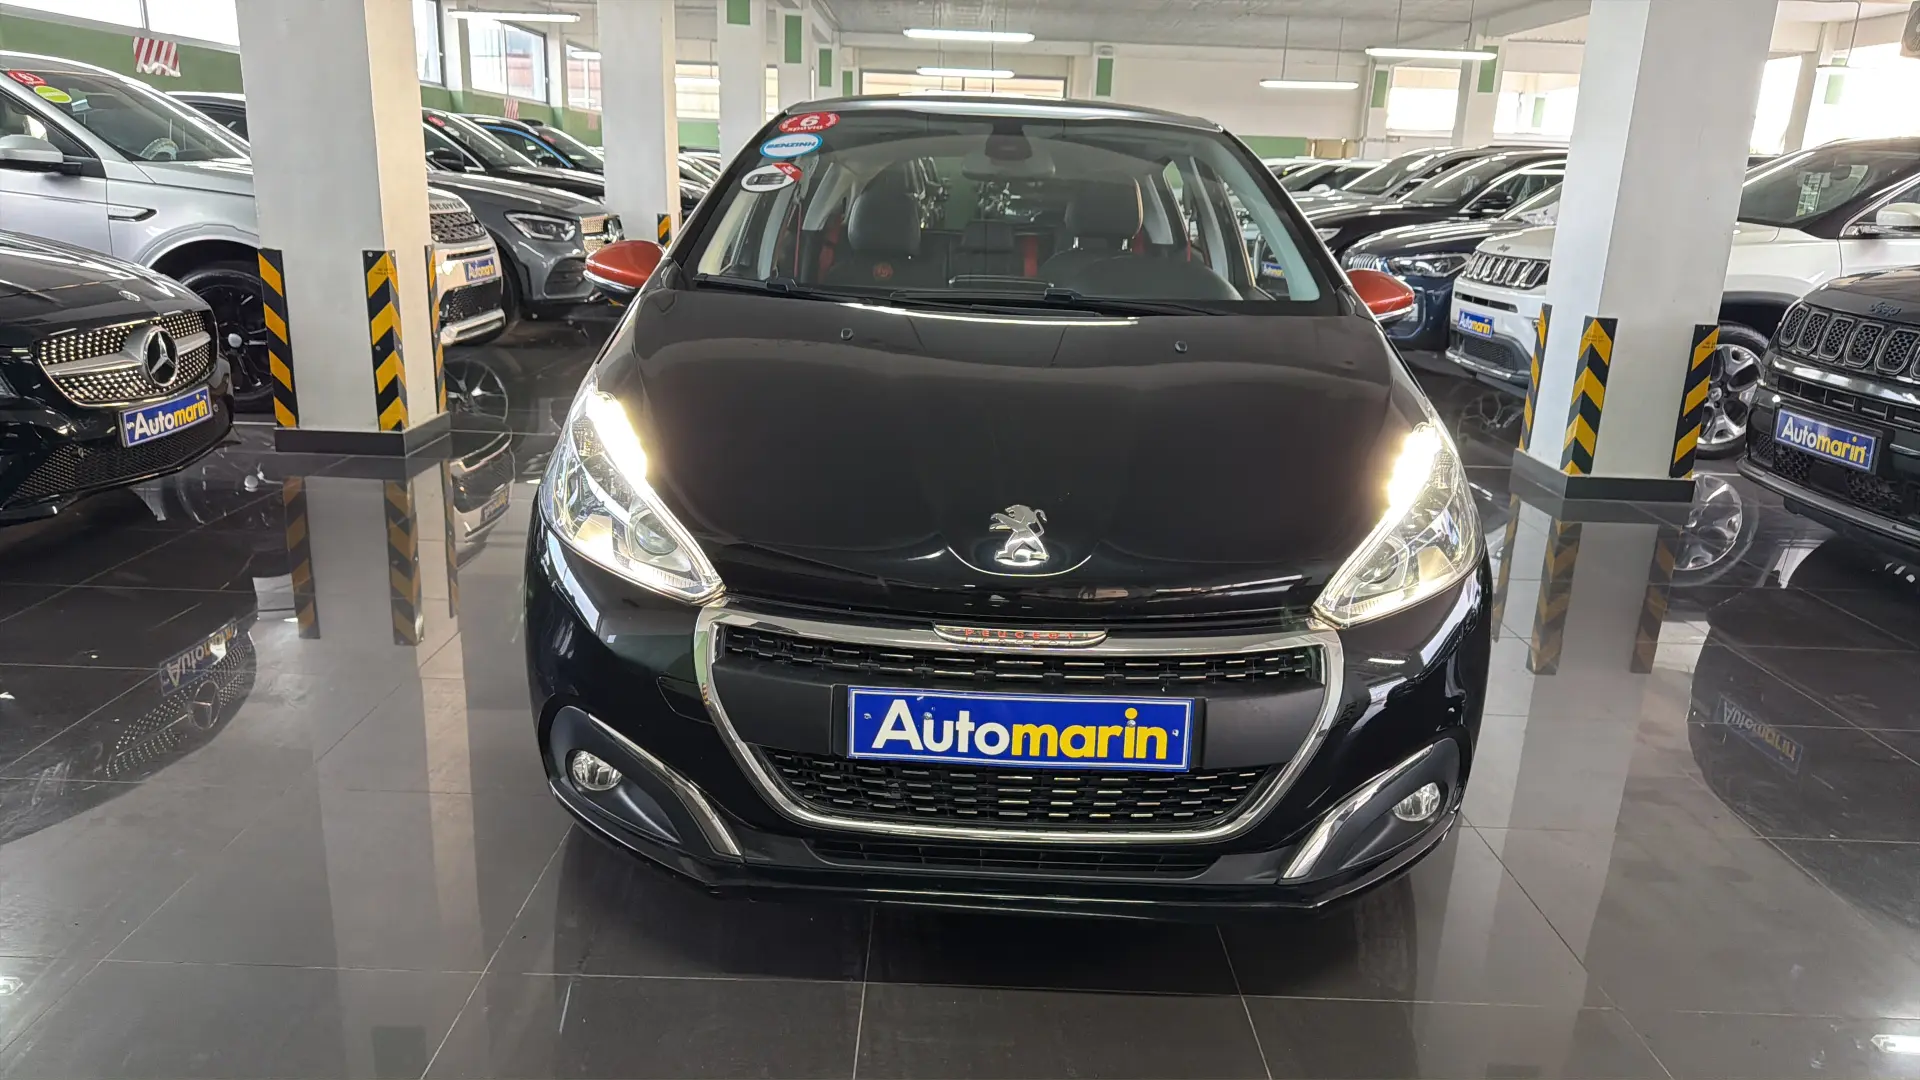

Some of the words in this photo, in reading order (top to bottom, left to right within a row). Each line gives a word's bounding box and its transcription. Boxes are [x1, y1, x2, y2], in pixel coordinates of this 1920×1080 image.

[800, 115, 820, 127] 6
[1870, 302, 1901, 316] Jeep
[134, 394, 208, 440] Automarin
[1781, 416, 1867, 464] Automarin
[872, 699, 1168, 760] Automarin
